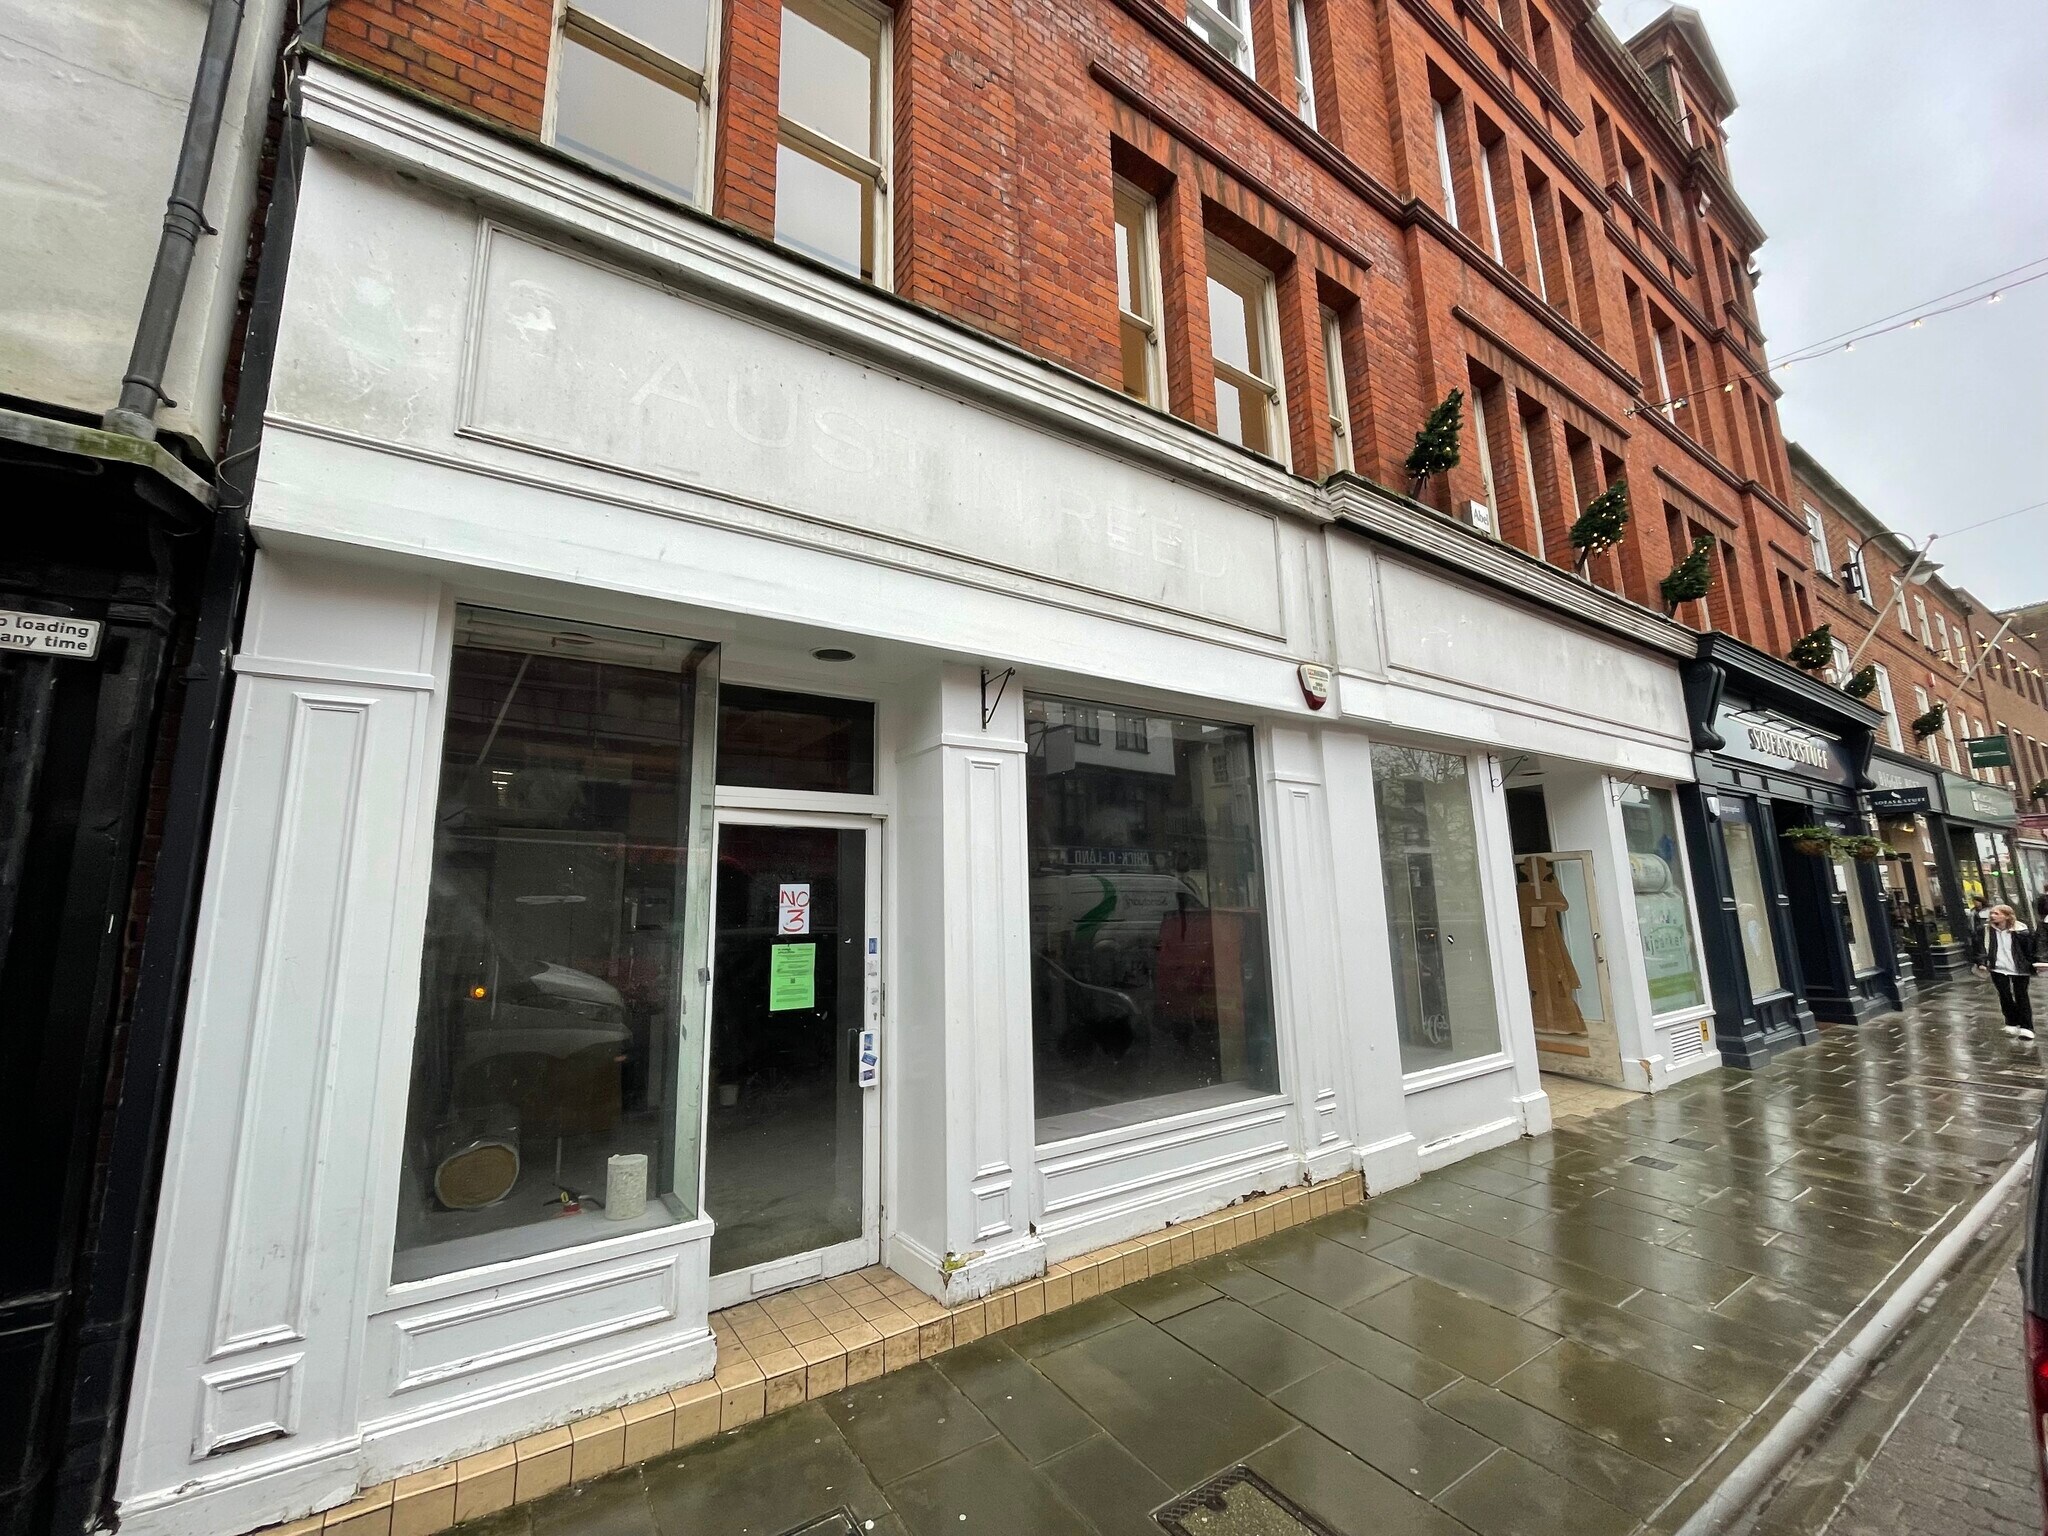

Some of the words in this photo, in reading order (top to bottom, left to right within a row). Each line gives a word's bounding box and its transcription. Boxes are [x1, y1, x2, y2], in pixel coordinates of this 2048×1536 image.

[15, 616, 90, 638] loading
[0, 632, 38, 647] any
[44, 635, 89, 651] time
[780, 889, 810, 908] NO
[782, 908, 805, 932] 3
